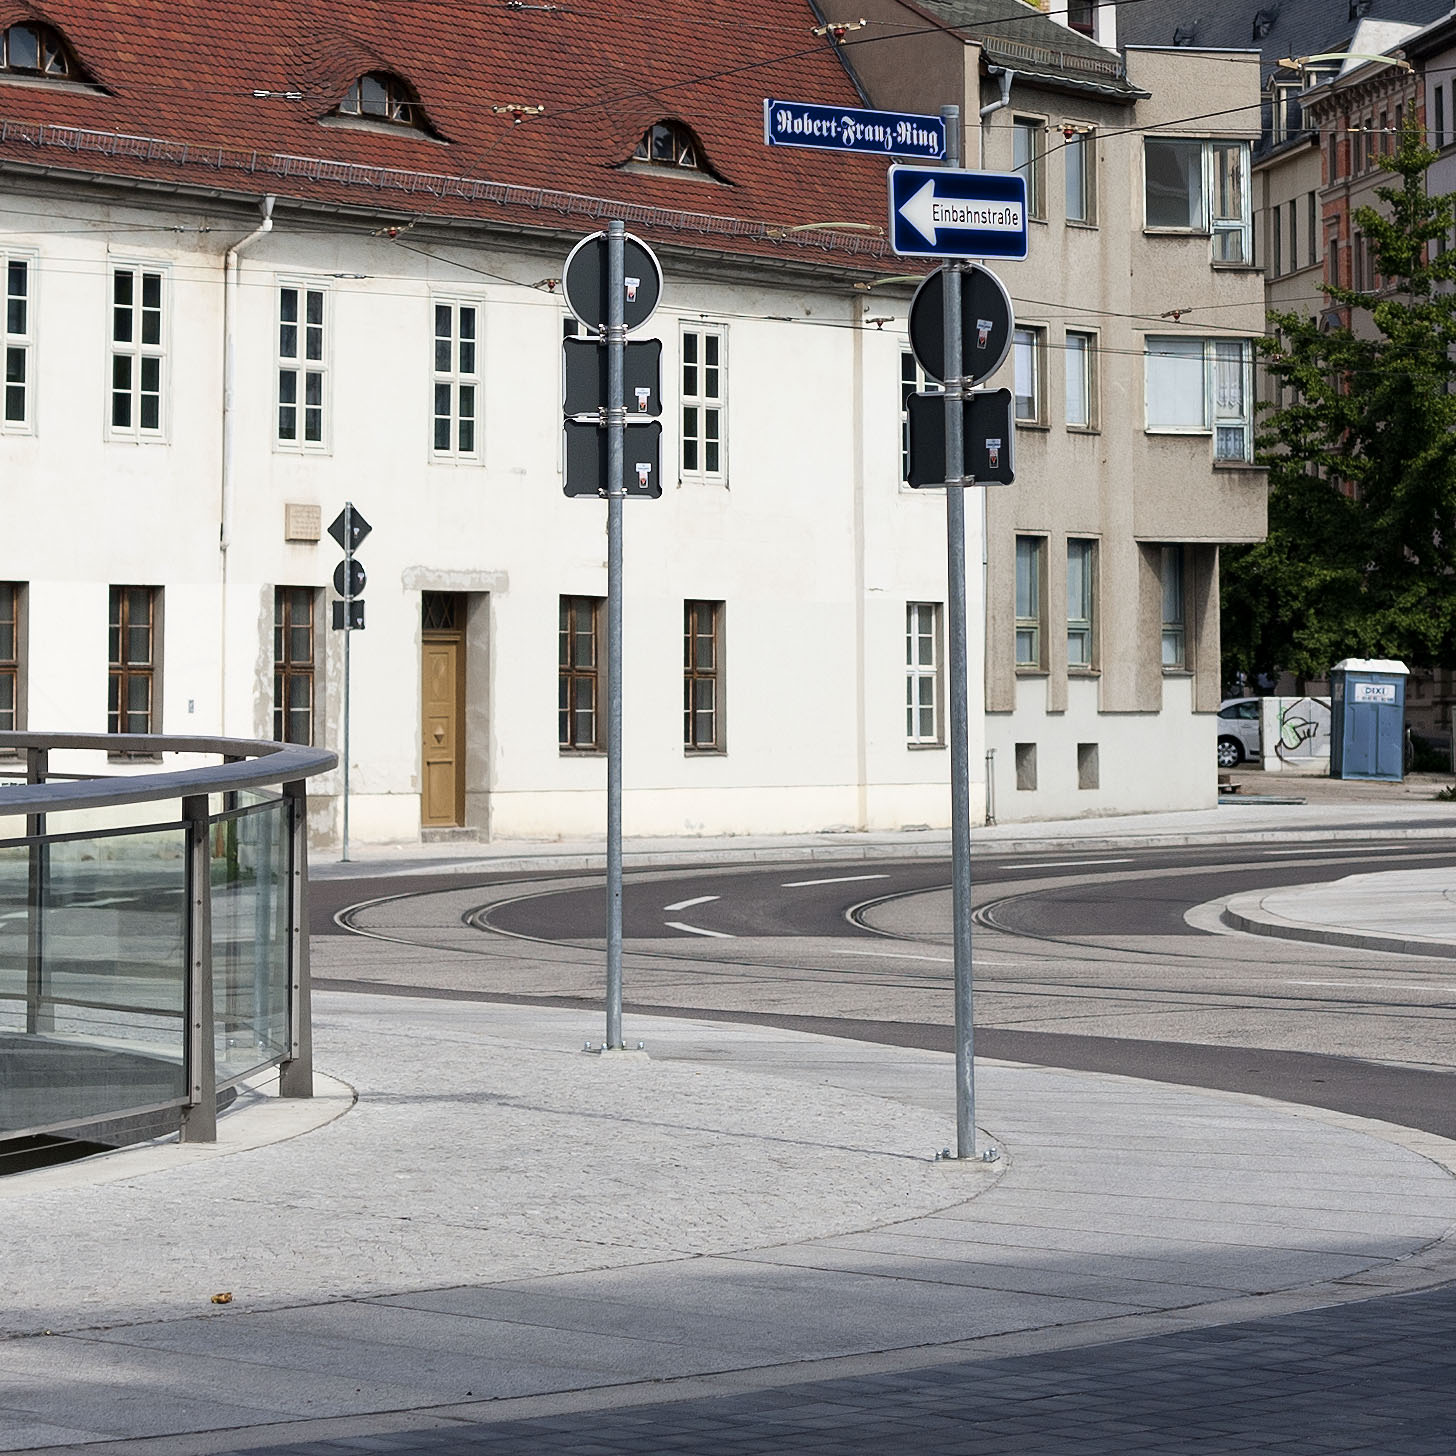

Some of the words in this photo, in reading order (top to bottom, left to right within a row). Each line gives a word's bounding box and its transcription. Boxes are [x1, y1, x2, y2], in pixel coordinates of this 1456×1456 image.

[776, 109, 939, 154] Robert-Franz-Ring
[932, 203, 1019, 226] Einbahnstraße
[1365, 687, 1385, 695] DIXI
